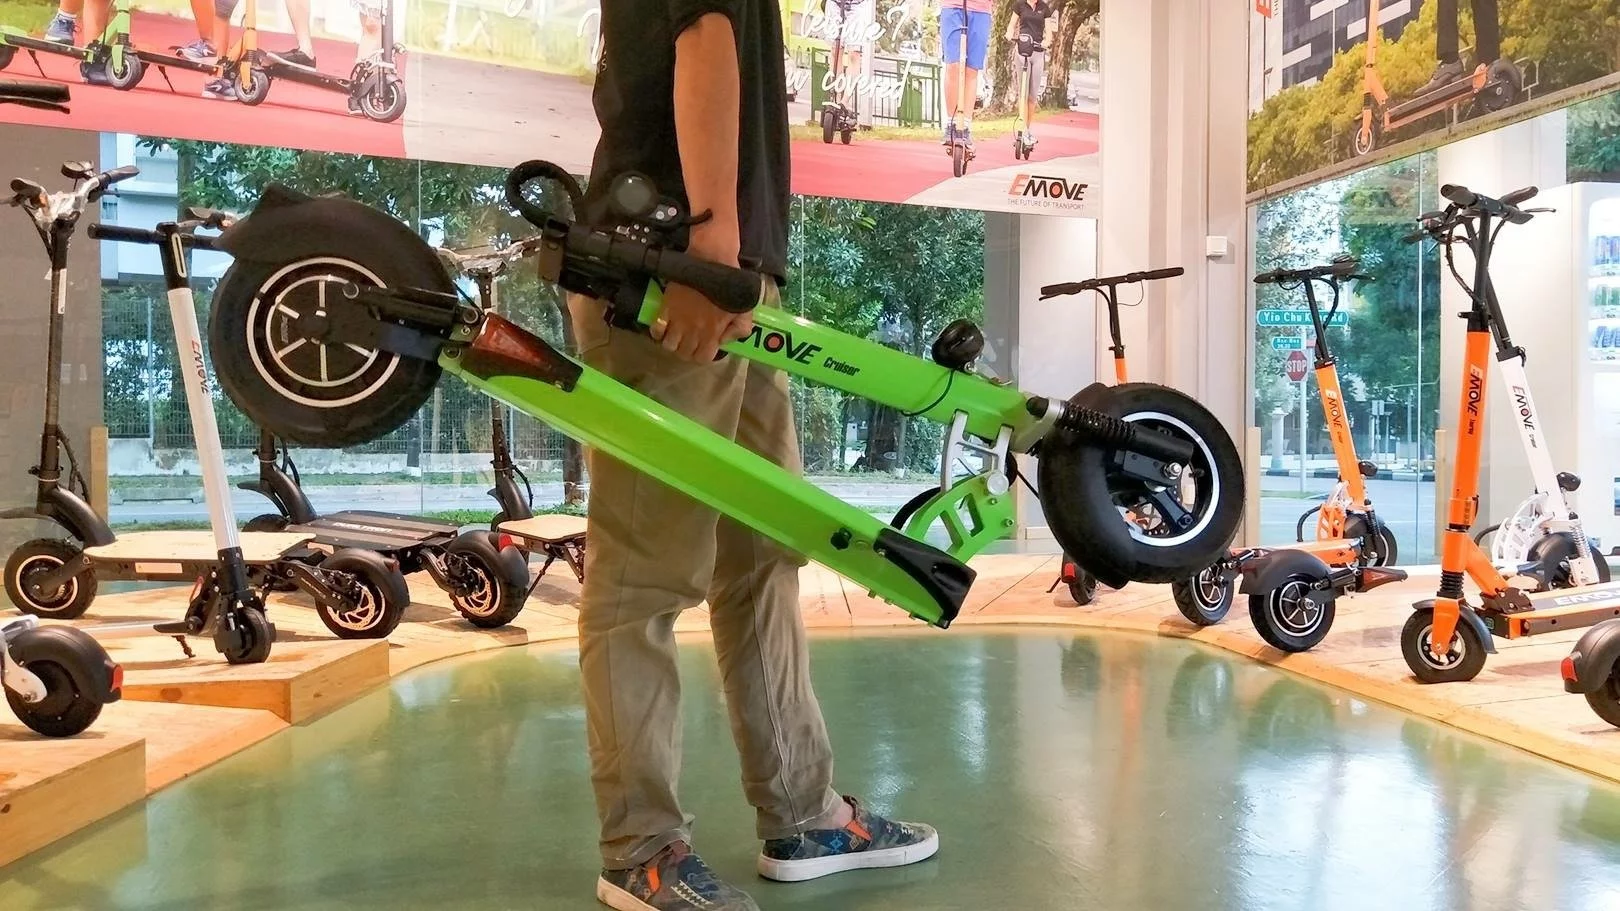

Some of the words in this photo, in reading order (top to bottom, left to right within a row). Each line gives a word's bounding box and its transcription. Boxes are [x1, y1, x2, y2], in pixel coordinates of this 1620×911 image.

[1008, 173, 1089, 201] EMOVE
[1007, 198, 1019, 206] THE
[1019, 199, 1041, 208] FUTURE
[1052, 201, 1085, 210] TRANSPORT
[1263, 311, 1281, 322] Yio
[1284, 311, 1302, 322] Chu
[737, 320, 822, 365] MOVE
[823, 356, 860, 377] Cruiser
[1287, 359, 1307, 373] STOP
[1468, 364, 1483, 416] EMOVE
[1512, 385, 1535, 430] EMOVE
